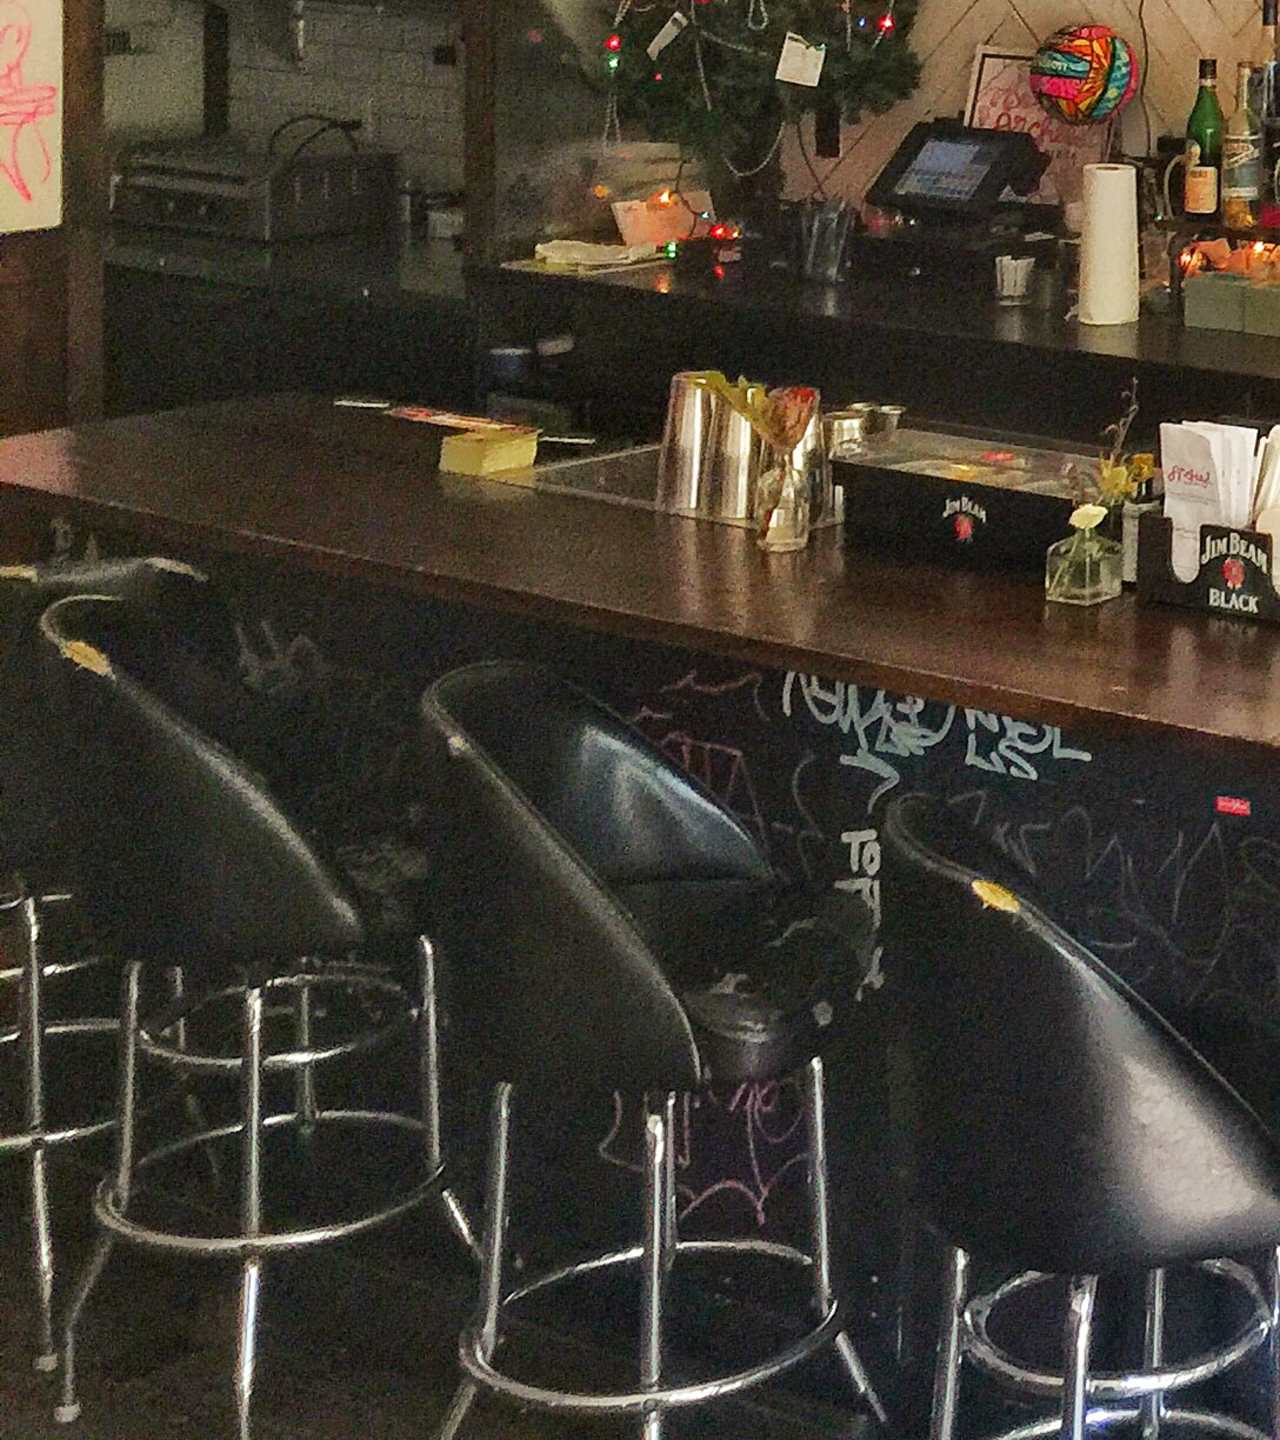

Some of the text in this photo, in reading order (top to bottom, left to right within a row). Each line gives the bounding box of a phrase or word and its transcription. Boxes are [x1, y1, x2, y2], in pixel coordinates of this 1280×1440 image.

[1201, 531, 1268, 575] JIM BEAM
[1208, 586, 1259, 615] BLACK
